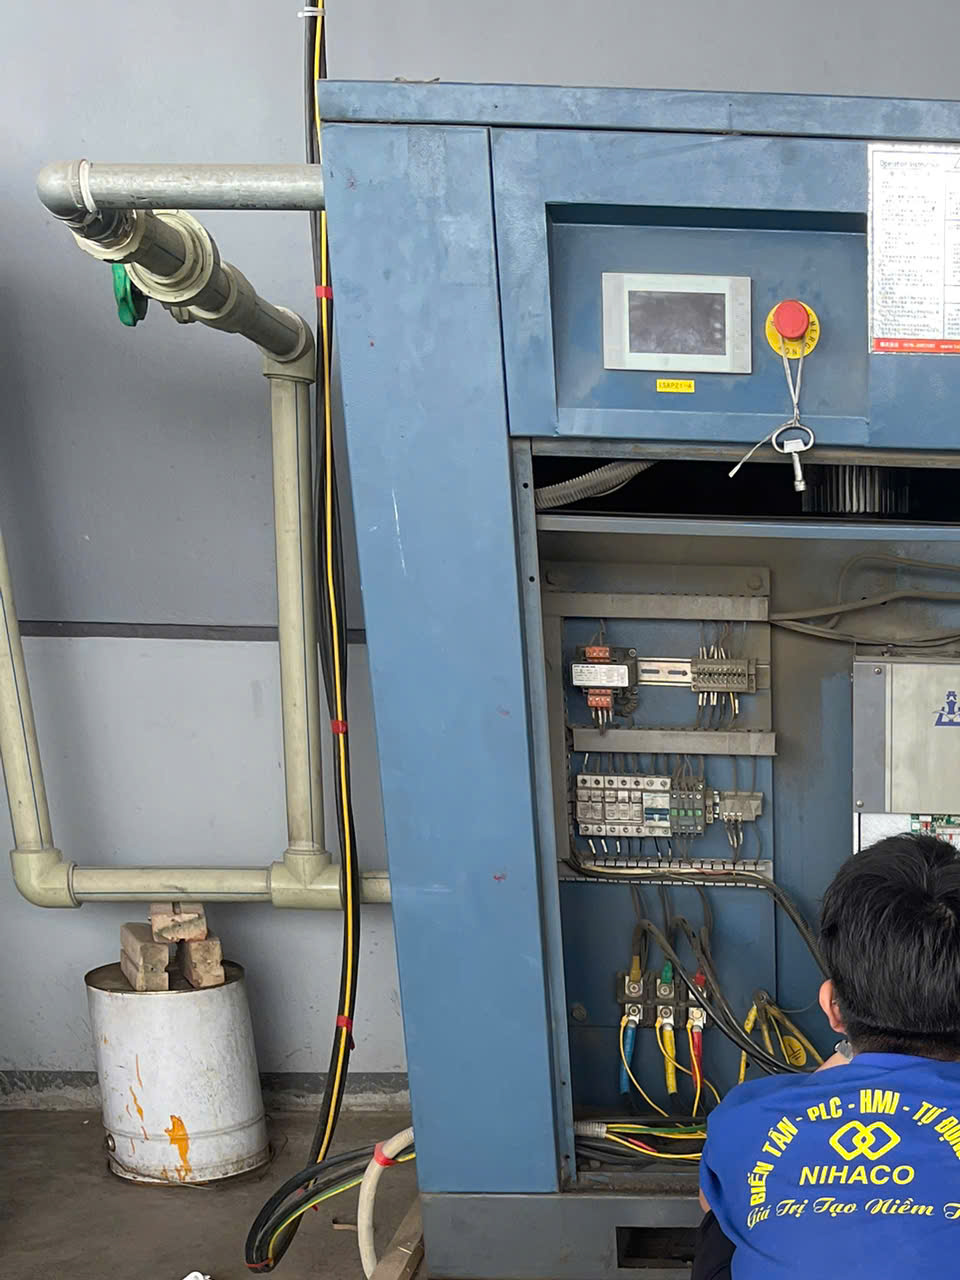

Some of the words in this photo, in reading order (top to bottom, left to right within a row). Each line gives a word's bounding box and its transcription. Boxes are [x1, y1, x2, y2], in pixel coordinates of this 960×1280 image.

[748, 1161, 774, 1205] BIẾN
[763, 1117, 798, 1157] TẦN
[807, 1096, 843, 1122] PLC
[859, 1089, 901, 1115] HMI
[912, 1101, 947, 1127] TỰ
[799, 1165, 916, 1186] NIHACO
[747, 1204, 772, 1231] Giá
[776, 1199, 809, 1218] Trị
[813, 1197, 857, 1219] Tạo
[865, 1196, 935, 1216] Niềm
